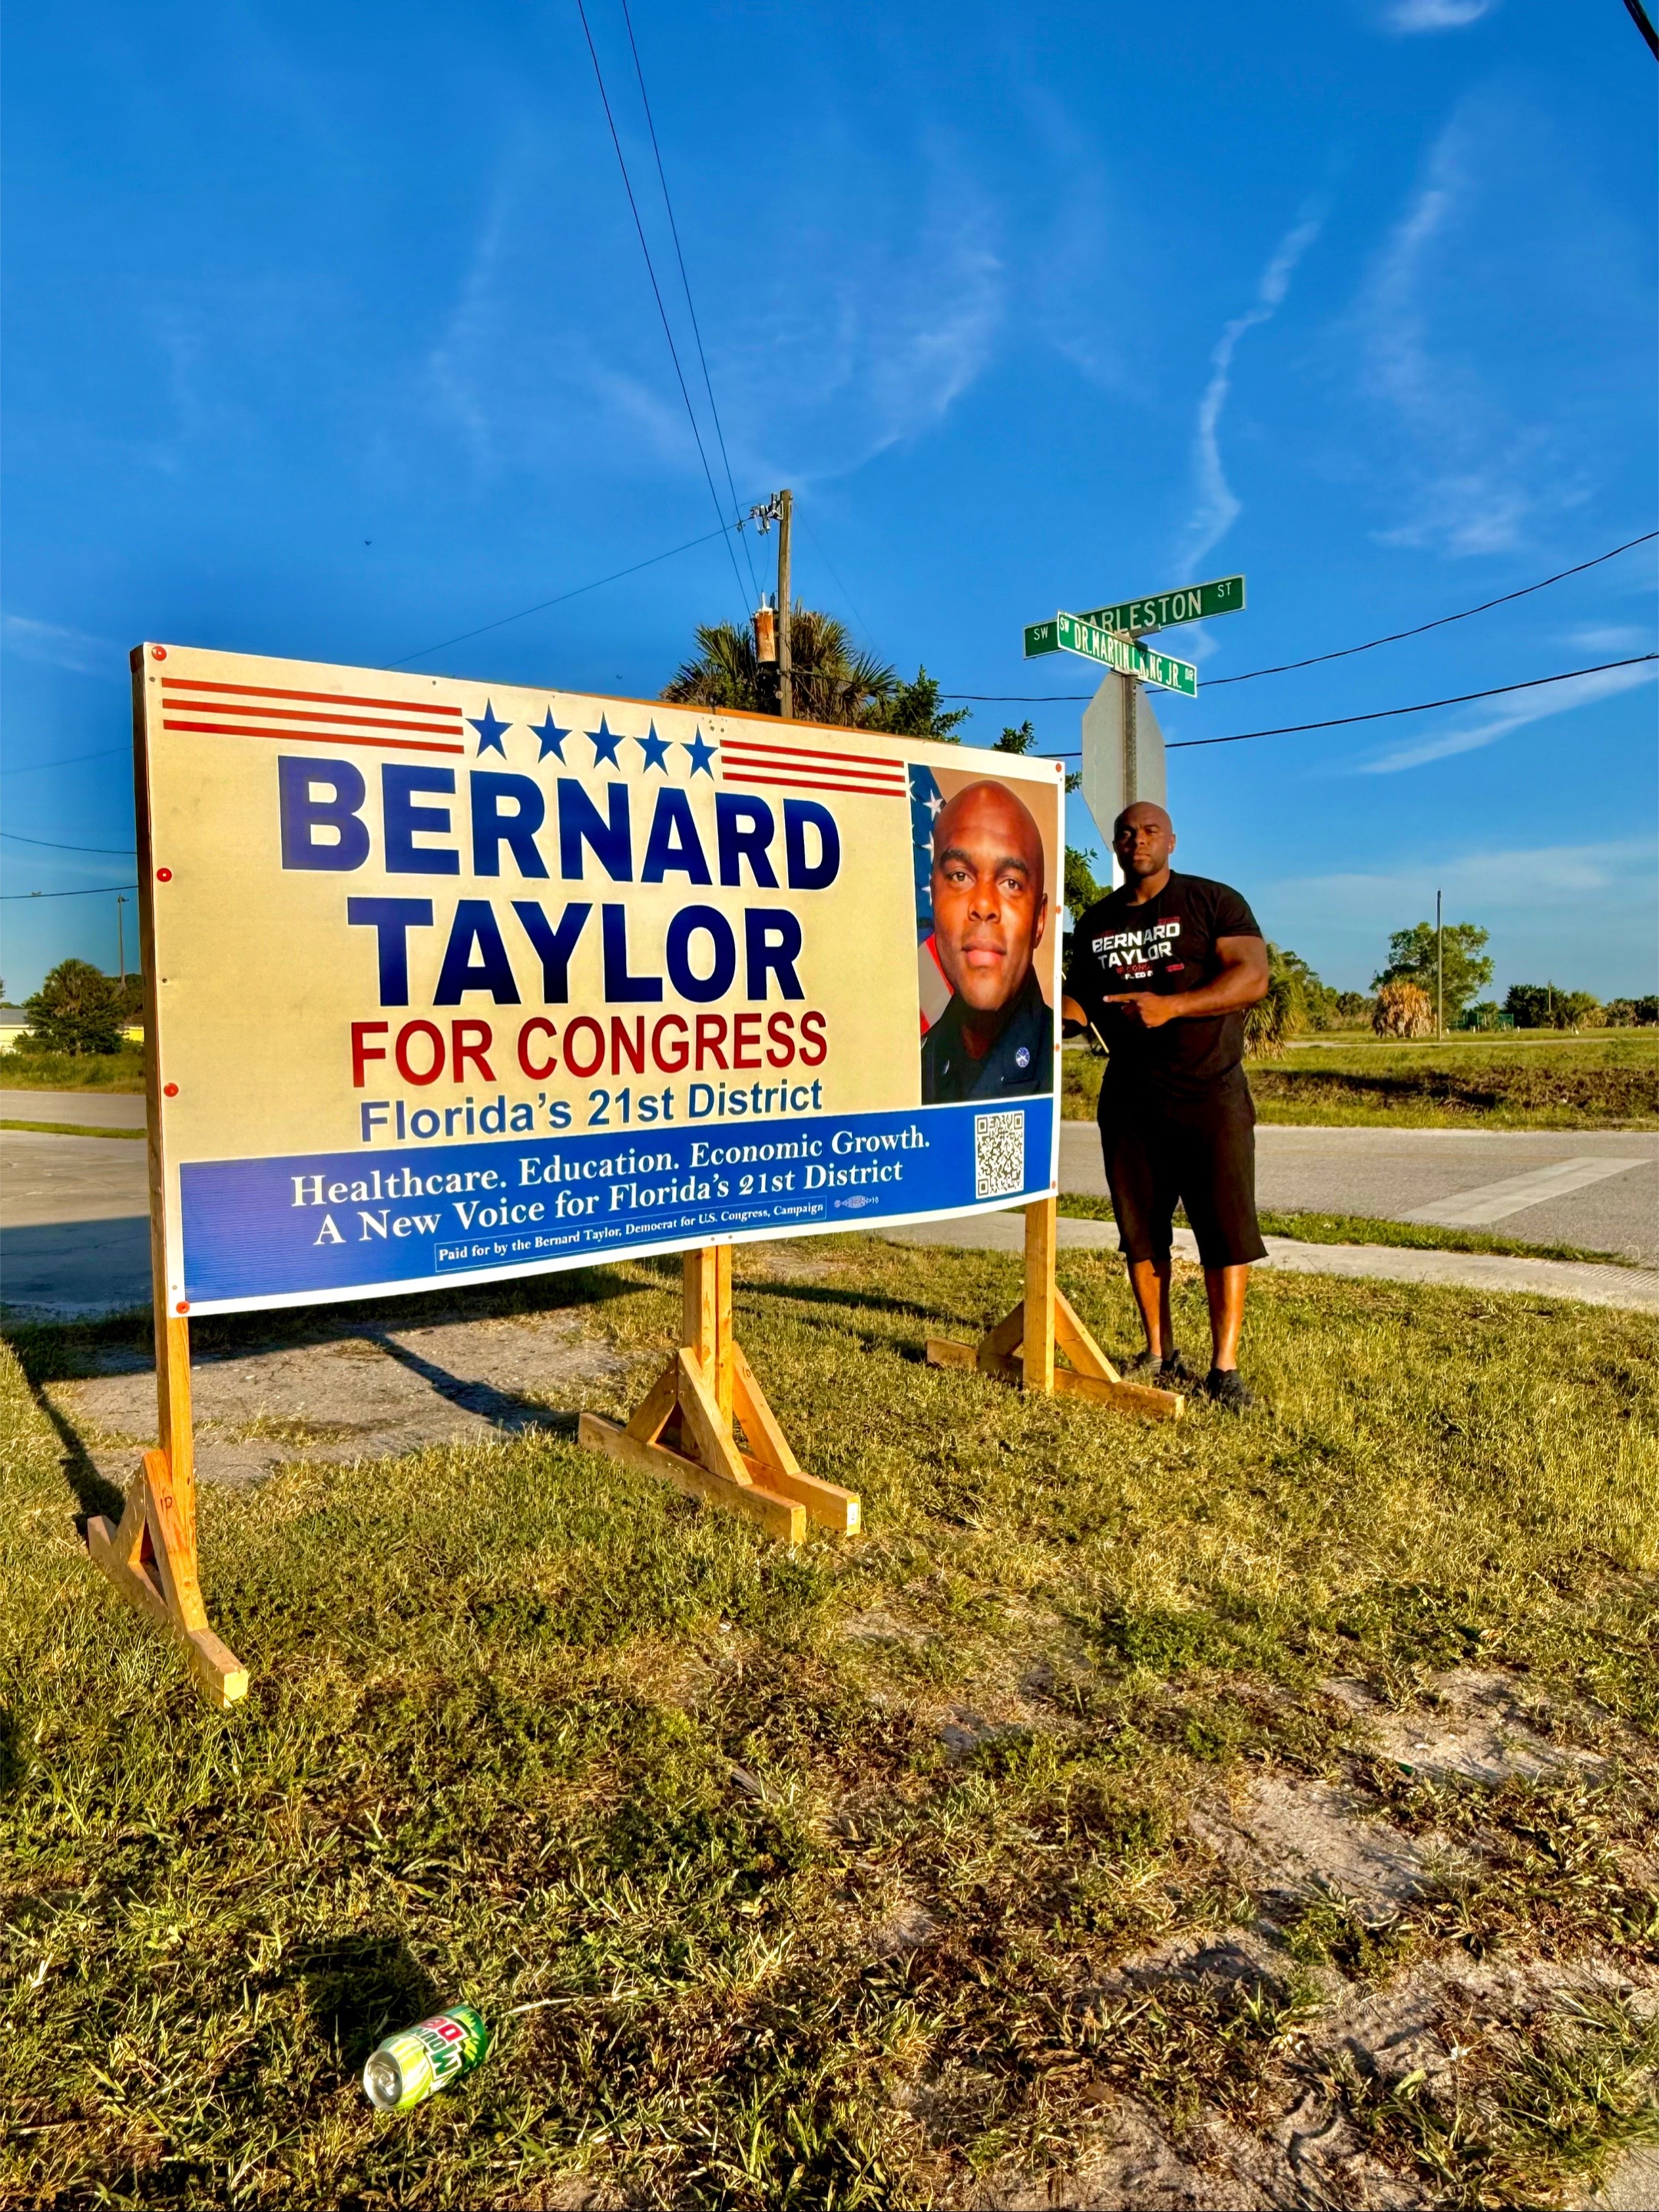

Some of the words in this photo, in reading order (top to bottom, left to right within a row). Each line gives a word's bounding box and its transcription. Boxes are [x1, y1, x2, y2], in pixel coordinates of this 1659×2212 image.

[1033, 626, 1048, 641] SW
[1079, 589, 1202, 632] ARLESTON
[1217, 582, 1232, 598] ST
[1060, 617, 1069, 634] SW
[277, 754, 841, 890] BERNARD
[347, 896, 806, 1007] TAYLOR
[1091, 922, 1181, 953] BERNARD
[1098, 941, 1173, 969] TAYLOR
[350, 1019, 498, 1088] FOR
[517, 1011, 828, 1080] CONGRESS
[360, 1094, 573, 1142] Florida's
[588, 1086, 674, 1126] 21st
[687, 1078, 823, 1119] District
[290, 1167, 507, 1207] Healthcare.
[518, 1147, 680, 1187] Education.
[689, 1133, 823, 1168] Economic
[831, 1124, 930, 1153] Growth.
[313, 1214, 346, 1246] A
[358, 1209, 442, 1242] New
[452, 1197, 545, 1230] Voice
[555, 1190, 600, 1219] for
[608, 1173, 729, 1211] Florida's
[738, 1172, 796, 1196] 21st
[803, 1158, 903, 1190] District
[439, 1247, 468, 1261] Paid
[472, 1245, 491, 1257] for
[494, 1242, 508, 1257] by
[512, 1240, 531, 1251] the
[535, 1230, 581, 1249] Bernard
[584, 1227, 623, 1242] Taylor,
[625, 1219, 677, 1235] Democrat
[680, 1216, 696, 1227] for
[698, 1212, 718, 1224] U.S.
[720, 1208, 771, 1223] Congress,
[773, 1201, 824, 1216] Campaign
